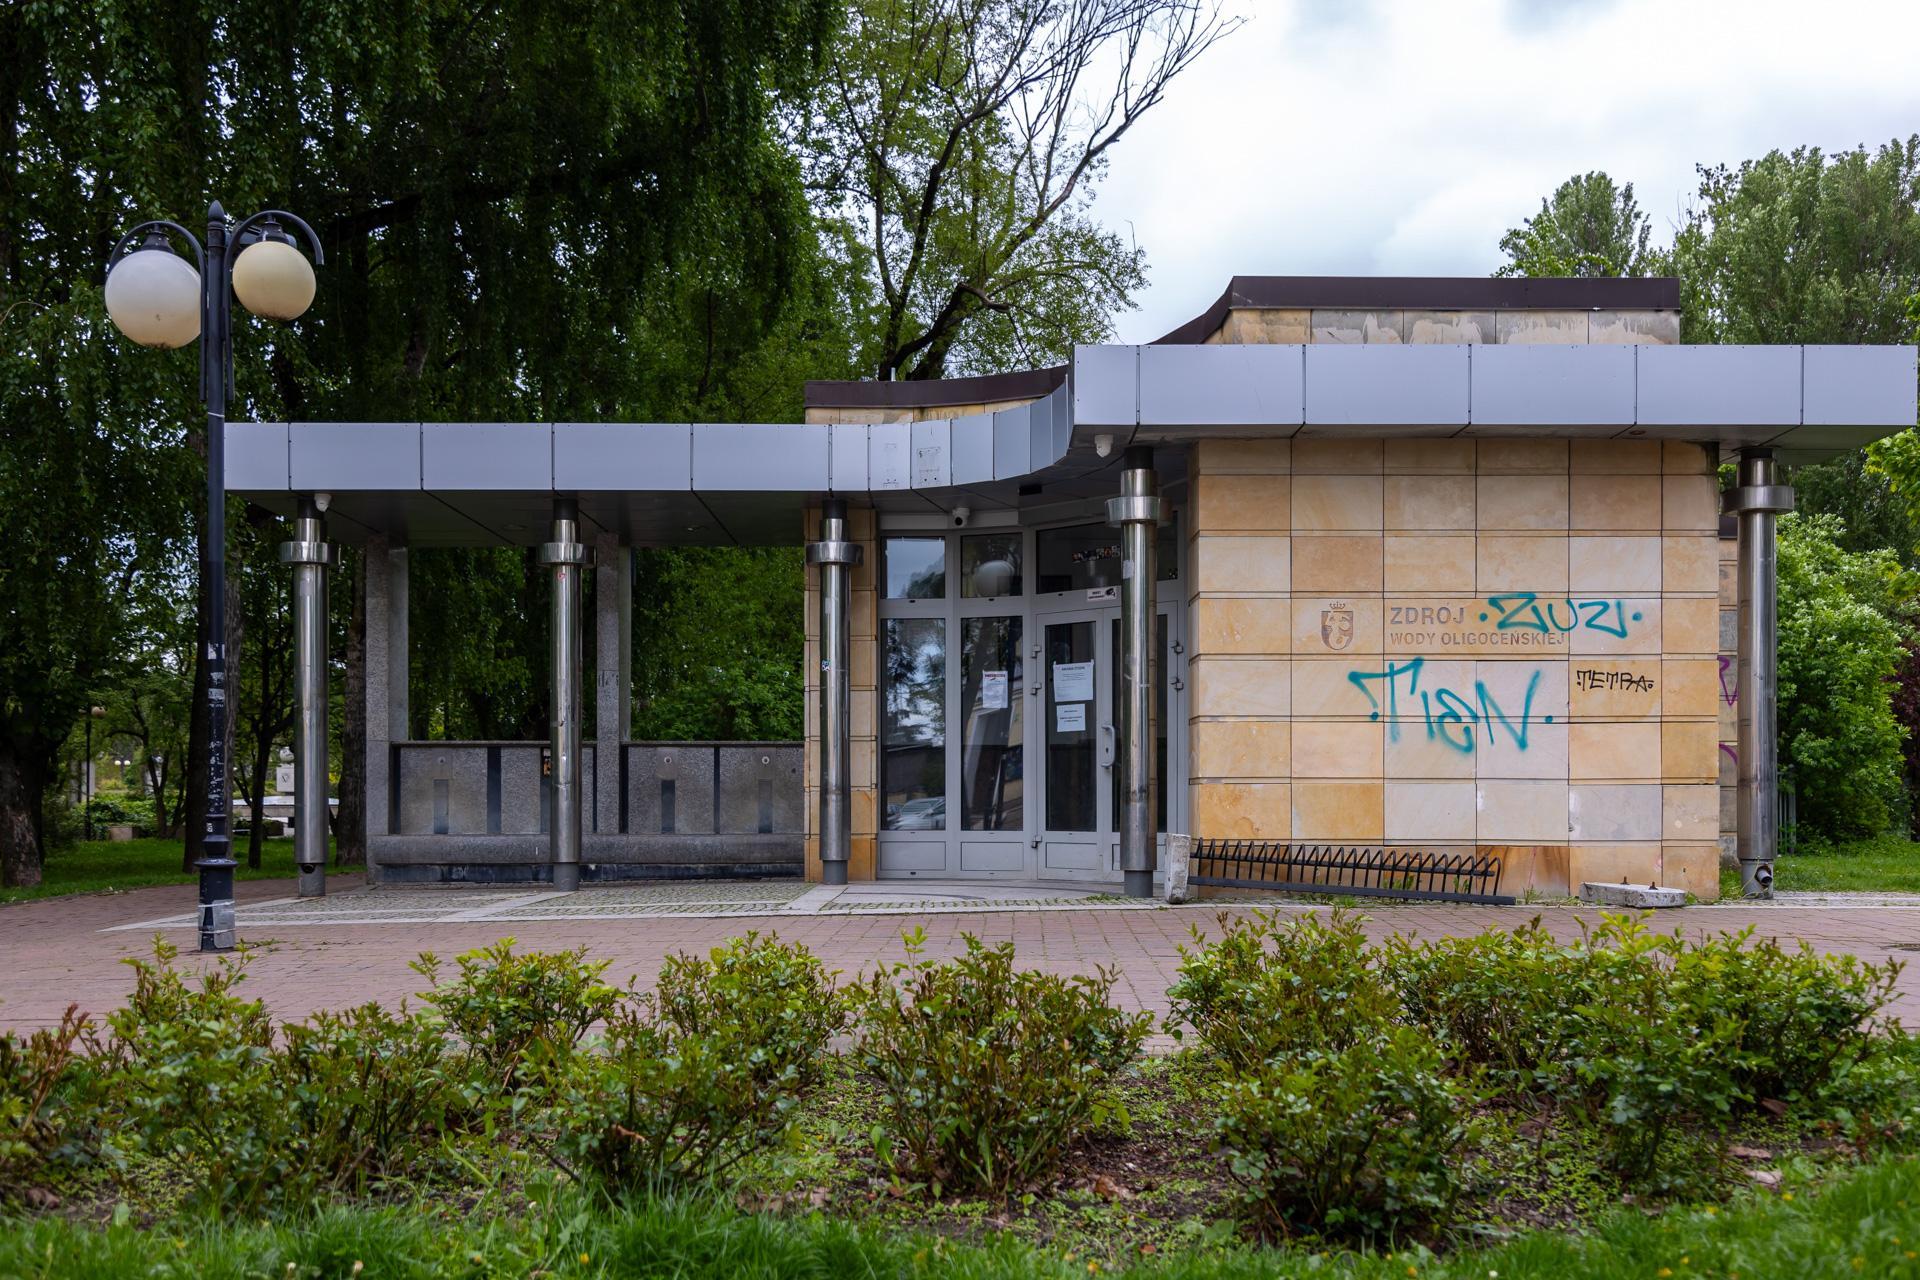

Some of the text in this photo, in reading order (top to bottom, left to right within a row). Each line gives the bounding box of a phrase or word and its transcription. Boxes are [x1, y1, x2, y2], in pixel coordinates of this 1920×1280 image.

[1390, 602, 1465, 625] ZDRÓJ
[1390, 630, 1566, 646] WODY OLIGOCEŃSKIEJ
